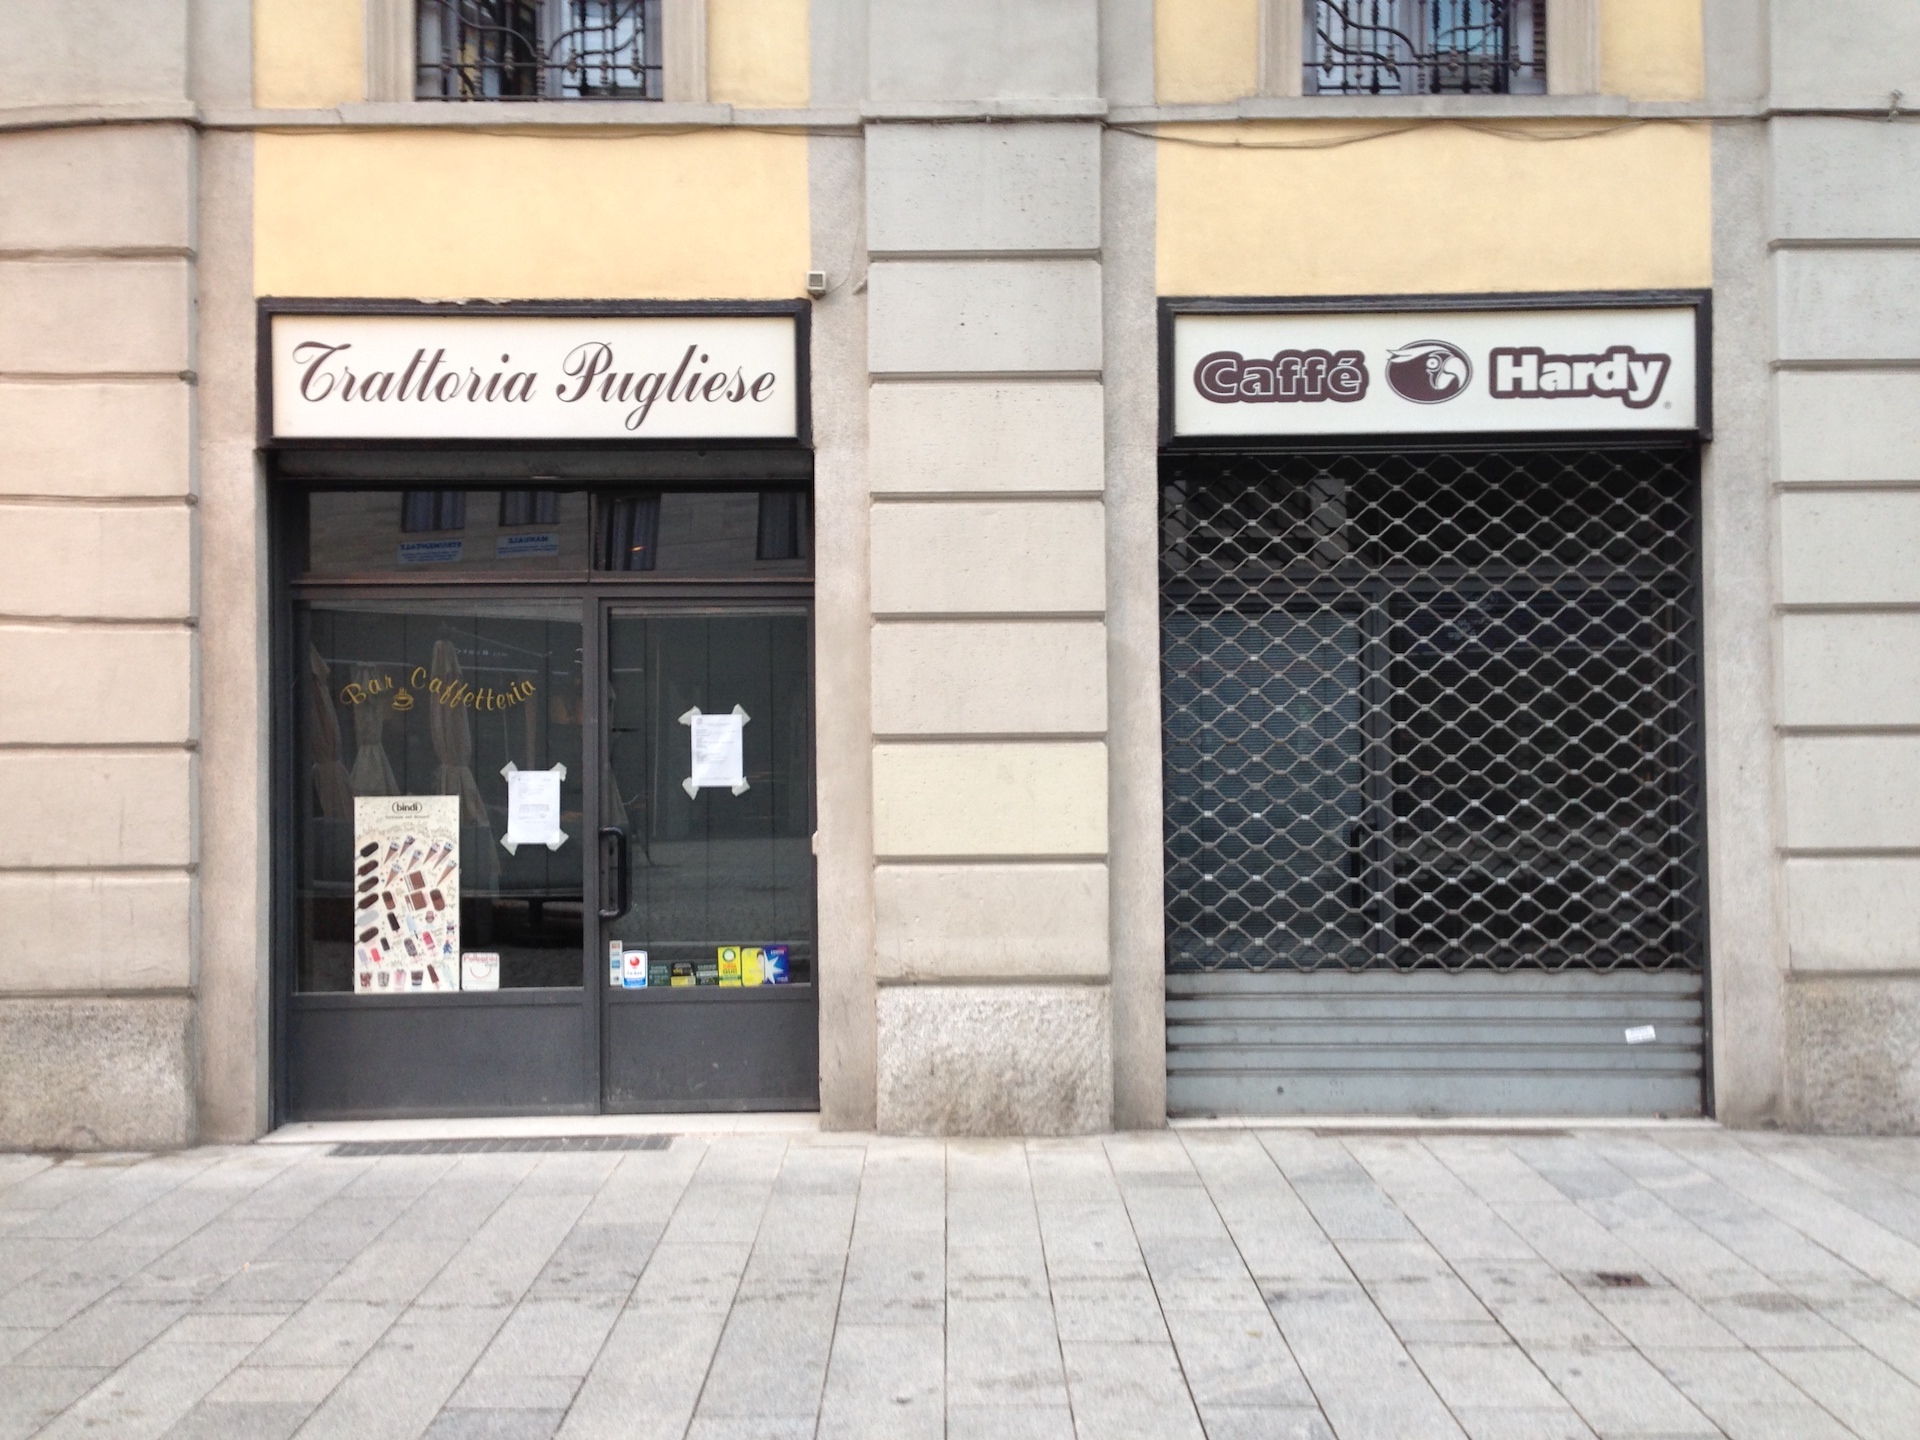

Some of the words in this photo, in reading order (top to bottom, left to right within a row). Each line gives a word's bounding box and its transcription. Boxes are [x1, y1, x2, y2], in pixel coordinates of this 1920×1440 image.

[292, 341, 537, 404] Trattoria
[555, 341, 776, 432] Pugliese
[1194, 349, 1370, 403] Caffé
[1489, 346, 1670, 409] Hardy
[340, 673, 393, 706] Bar
[410, 666, 537, 712] Caffetteria
[396, 803, 418, 812] bindi
